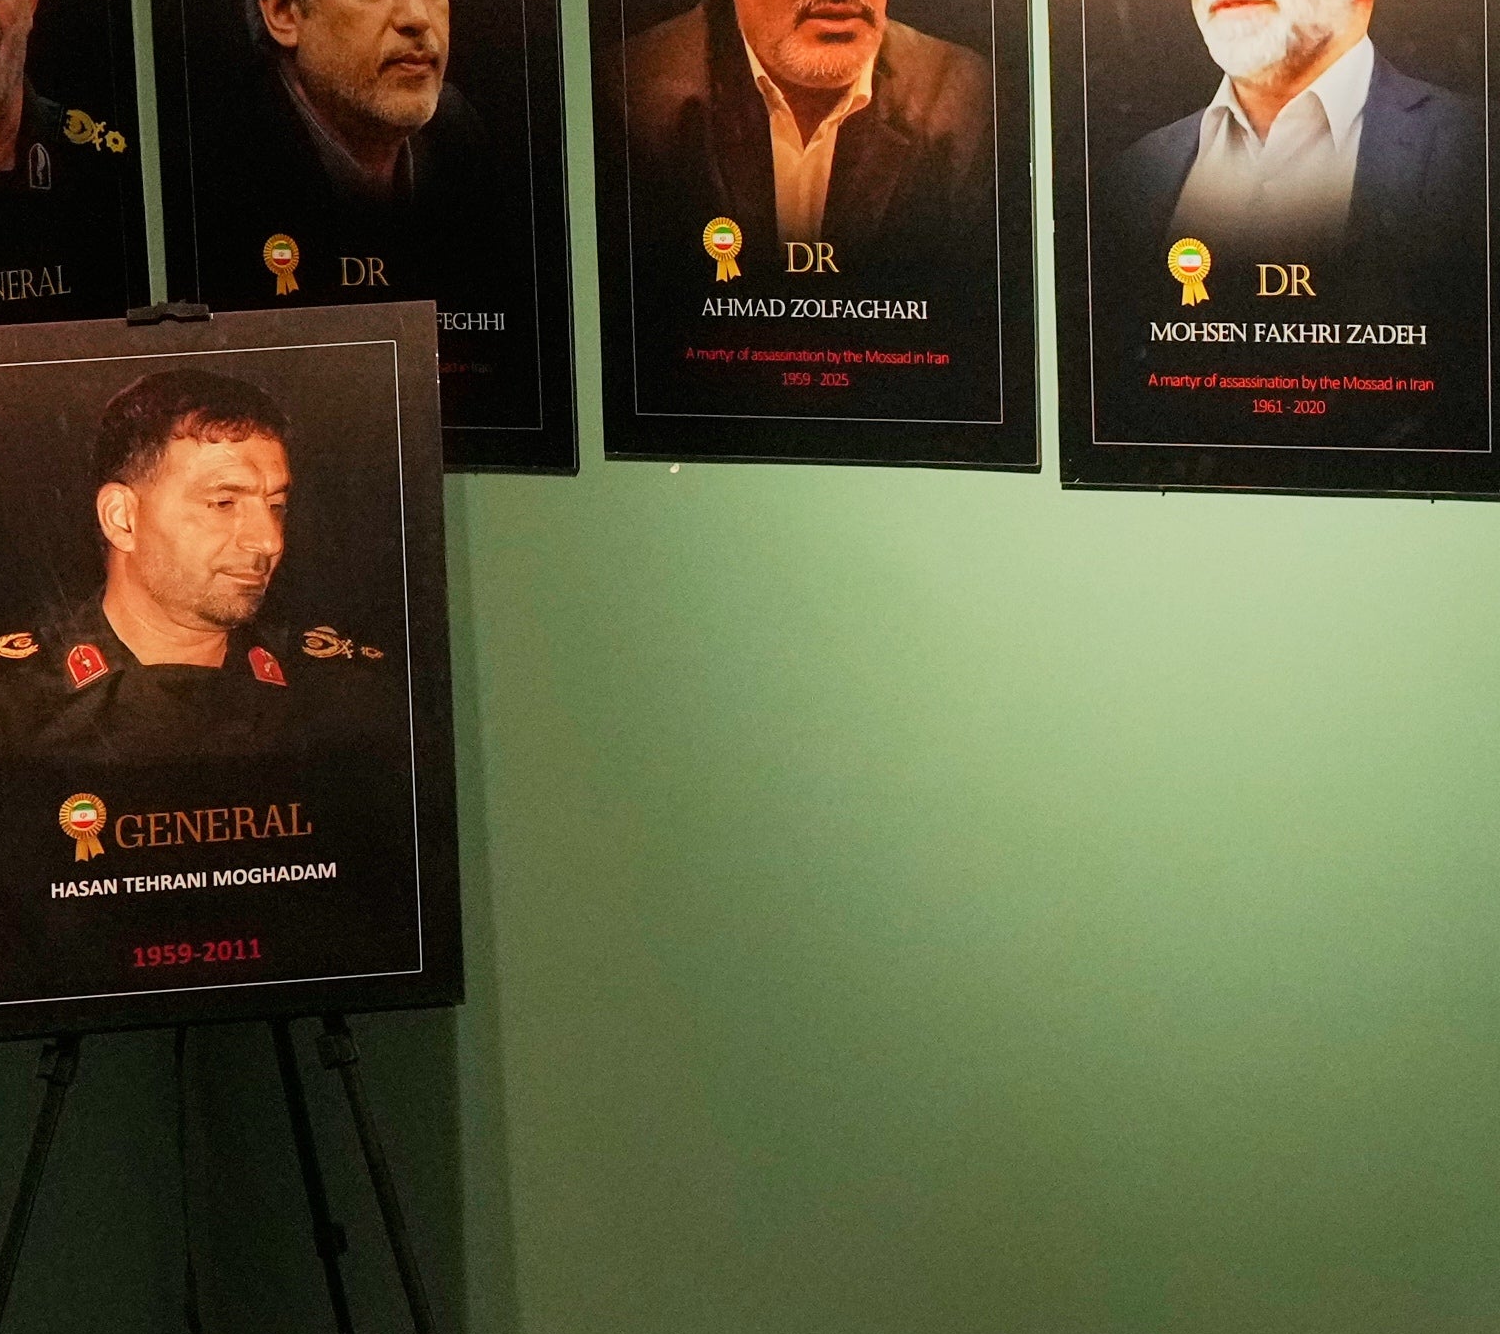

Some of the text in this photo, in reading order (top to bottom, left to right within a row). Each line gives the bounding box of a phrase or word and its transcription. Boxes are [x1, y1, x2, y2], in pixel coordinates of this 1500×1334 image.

[785, 242, 840, 273] DR
[340, 257, 389, 286] DR
[1256, 263, 1316, 296] DR
[436, 312, 505, 331] FEGHHI
[702, 297, 927, 320] AHMAD ZOLFAGHARI
[1150, 322, 1427, 345] MOHSEN FAKHRI ZADEH
[685, 346, 949, 365] A martyr of assassination by the Mossad in Iran
[1149, 373, 1434, 391] A martyr of assassination by the Mossad in Iran
[1252, 399, 1325, 414] 1961 2020
[115, 802, 313, 849] GENERAL
[50, 862, 337, 899] HASAN TEHRANI MOGHADAM
[132, 937, 262, 967] 1959-2011
